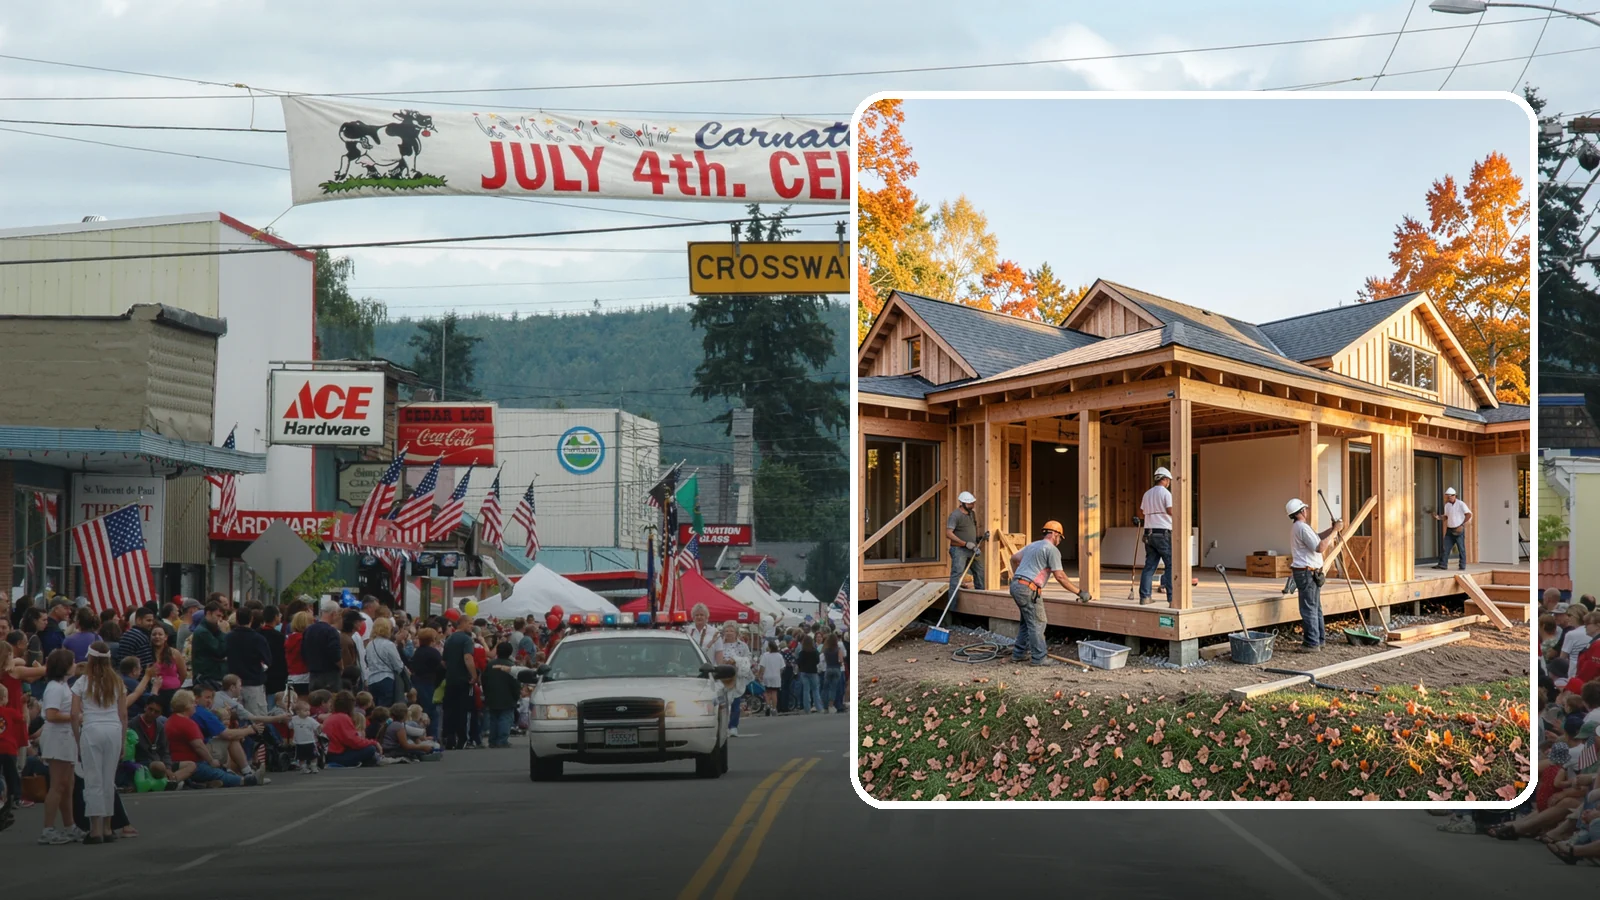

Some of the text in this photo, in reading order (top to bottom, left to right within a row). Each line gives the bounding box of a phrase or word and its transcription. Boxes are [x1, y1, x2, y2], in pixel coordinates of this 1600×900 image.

[481, 141, 605, 192] JULY
[632, 150, 746, 198] 4th.
[697, 254, 850, 280] CROSSWA
[283, 380, 373, 420] ACE
[405, 409, 485, 422] CEDAR LOG
[283, 421, 371, 436] Hardware
[416, 428, 476, 447] Coca-Cola
[354, 468, 385, 480] Simpl
[83, 485, 155, 495] St. Vincent de Paul
[688, 527, 741, 535] CRNATION
